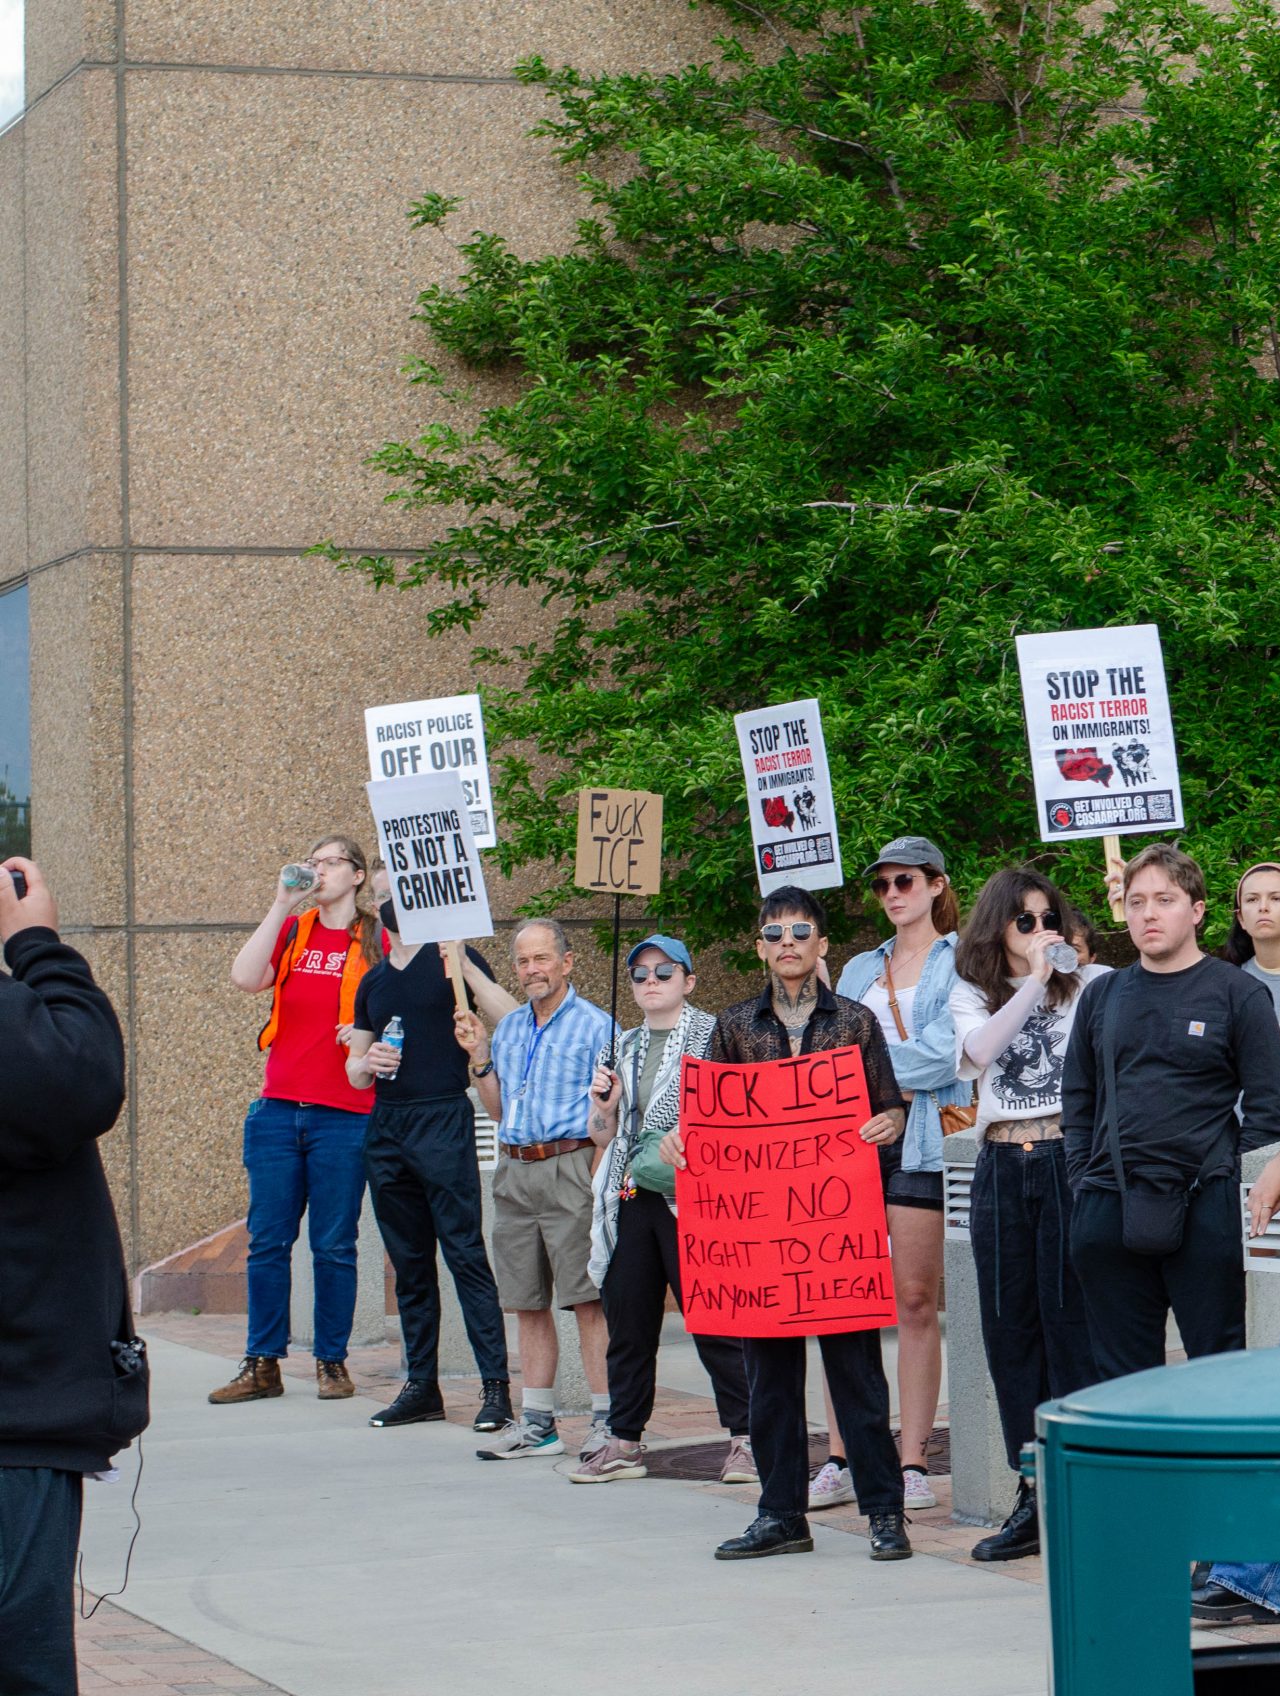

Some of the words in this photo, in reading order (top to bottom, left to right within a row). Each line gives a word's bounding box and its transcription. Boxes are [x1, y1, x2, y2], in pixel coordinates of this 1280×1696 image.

[1047, 669, 1099, 700] STOP
[1106, 666, 1146, 696] THE
[377, 720, 422, 743] RACIST
[428, 713, 473, 734] POLICE
[1051, 702, 1095, 721] RACIST
[1099, 698, 1148, 718] TERROR
[750, 725, 780, 754] STOP
[783, 719, 809, 748] THE
[1053, 725, 1068, 740] ON
[1072, 719, 1151, 740] IMMIGRANTS!
[381, 744, 422, 778] OFF
[430, 737, 477, 770] OUR
[755, 753, 780, 774] RACIST
[782, 748, 812, 769] TERROR
[758, 776, 767, 791] ON
[769, 767, 815, 789] IMMIGRANTS!
[590, 793, 647, 837] FUCK
[1074, 800, 1090, 813] GET
[1091, 796, 1132, 811] INVOLVED
[1133, 796, 1144, 808] @
[1075, 808, 1147, 826] COSAARPR.ORG
[383, 810, 460, 841] PROTESTING
[389, 842, 408, 873] IS
[412, 837, 451, 868] NOT
[455, 834, 468, 862] A
[590, 836, 644, 890] ICE
[397, 867, 476, 911] CRIME!
[684, 1062, 768, 1118] FUCK
[778, 1051, 860, 1111] ICE
[685, 1129, 855, 1177] COLONIZERS
[694, 1182, 768, 1220] HAVE
[787, 1175, 850, 1222] NO
[683, 1233, 761, 1268] RIGHT
[769, 1237, 810, 1265] TO
[819, 1229, 889, 1263] CALL
[686, 1279, 781, 1319] ANYONE
[782, 1270, 893, 1317] ILLEGAL
